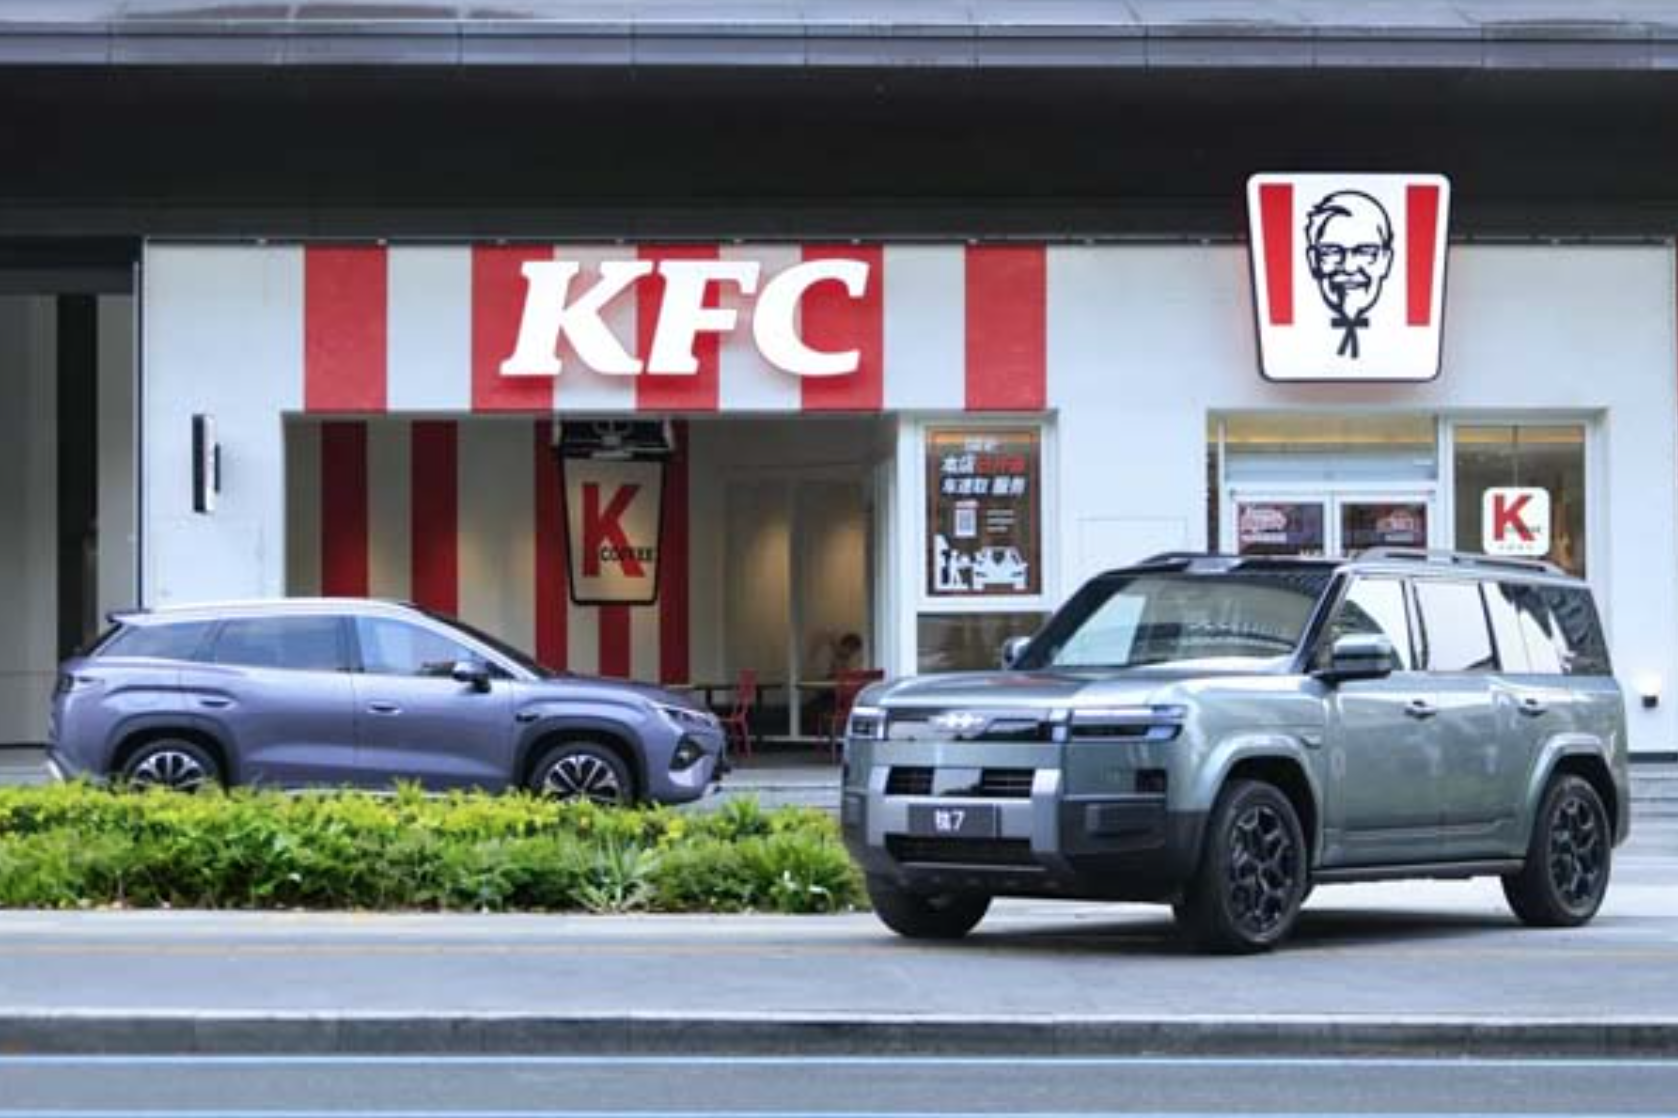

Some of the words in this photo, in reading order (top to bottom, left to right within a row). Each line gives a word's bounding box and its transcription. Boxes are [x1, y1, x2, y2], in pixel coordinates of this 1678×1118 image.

[500, 259, 870, 376] KFC
[582, 483, 645, 578] K
[1494, 494, 1534, 541] K
